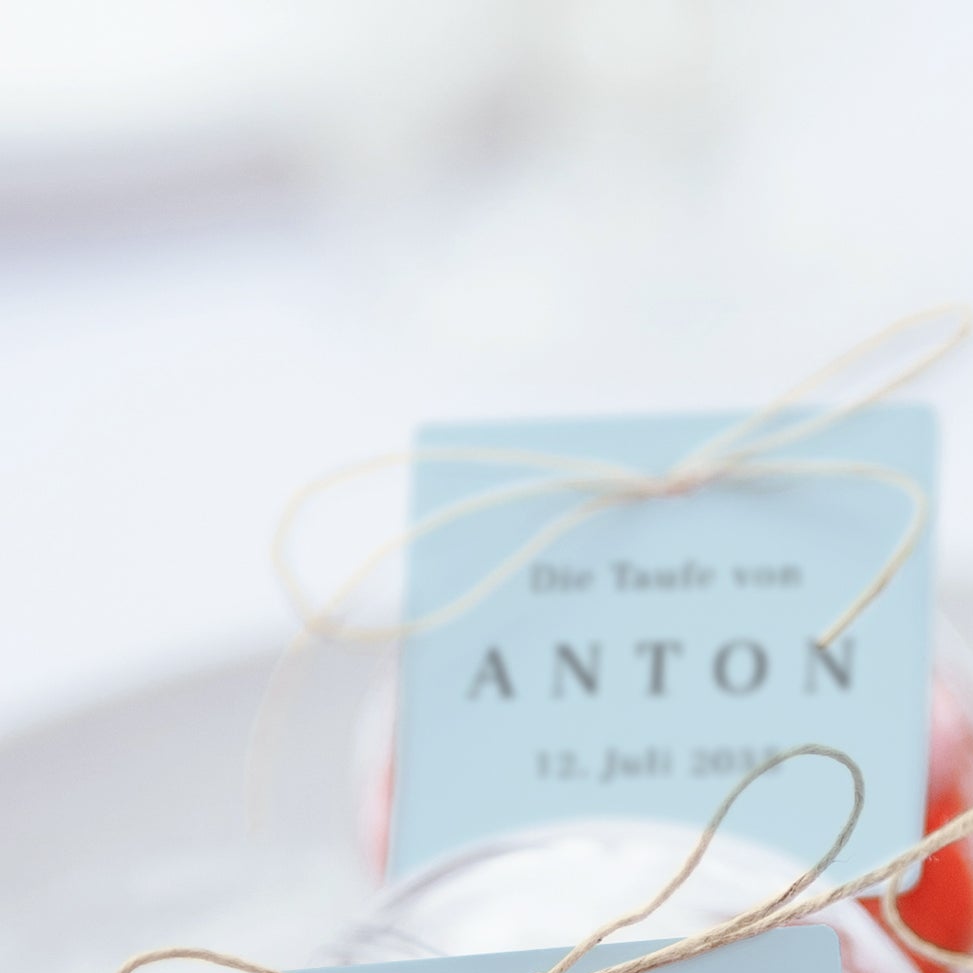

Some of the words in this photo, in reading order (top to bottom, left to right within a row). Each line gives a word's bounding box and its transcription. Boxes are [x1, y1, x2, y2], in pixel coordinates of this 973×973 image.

[530, 563, 593, 593] Die
[610, 559, 715, 592] Taufe
[732, 564, 803, 589] von
[466, 637, 856, 702] ANTON
